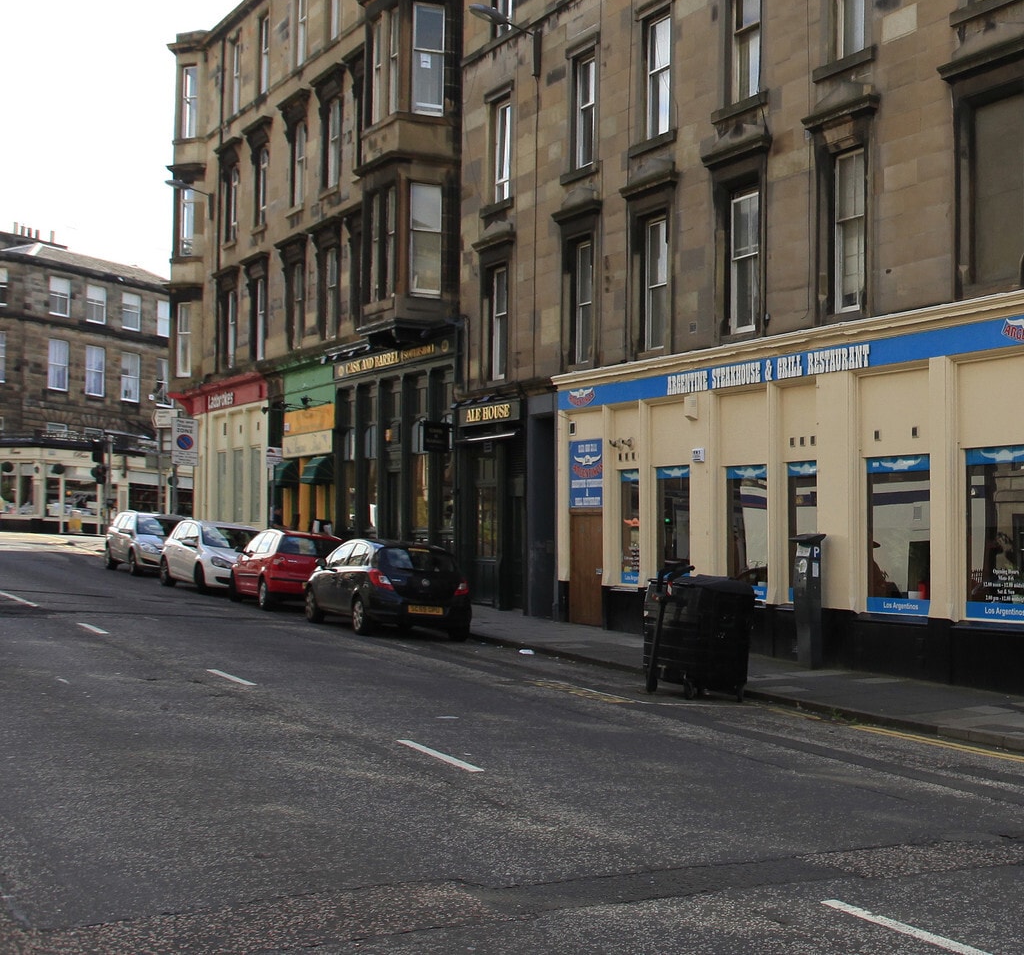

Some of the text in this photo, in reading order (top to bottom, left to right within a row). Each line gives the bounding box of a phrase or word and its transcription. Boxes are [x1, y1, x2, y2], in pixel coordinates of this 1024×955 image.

[345, 361, 361, 375] CASK
[361, 356, 374, 371] AND
[374, 350, 400, 368] BARREL
[667, 344, 870, 396] ARGENTINE STEAKHOUSE & GRILL RESTAURANT
[207, 391, 234, 410] Ladbrokes
[465, 403, 511, 423] ALE HOUSE
[813, 546, 820, 558] P
[883, 601, 919, 611] Los Argentinos
